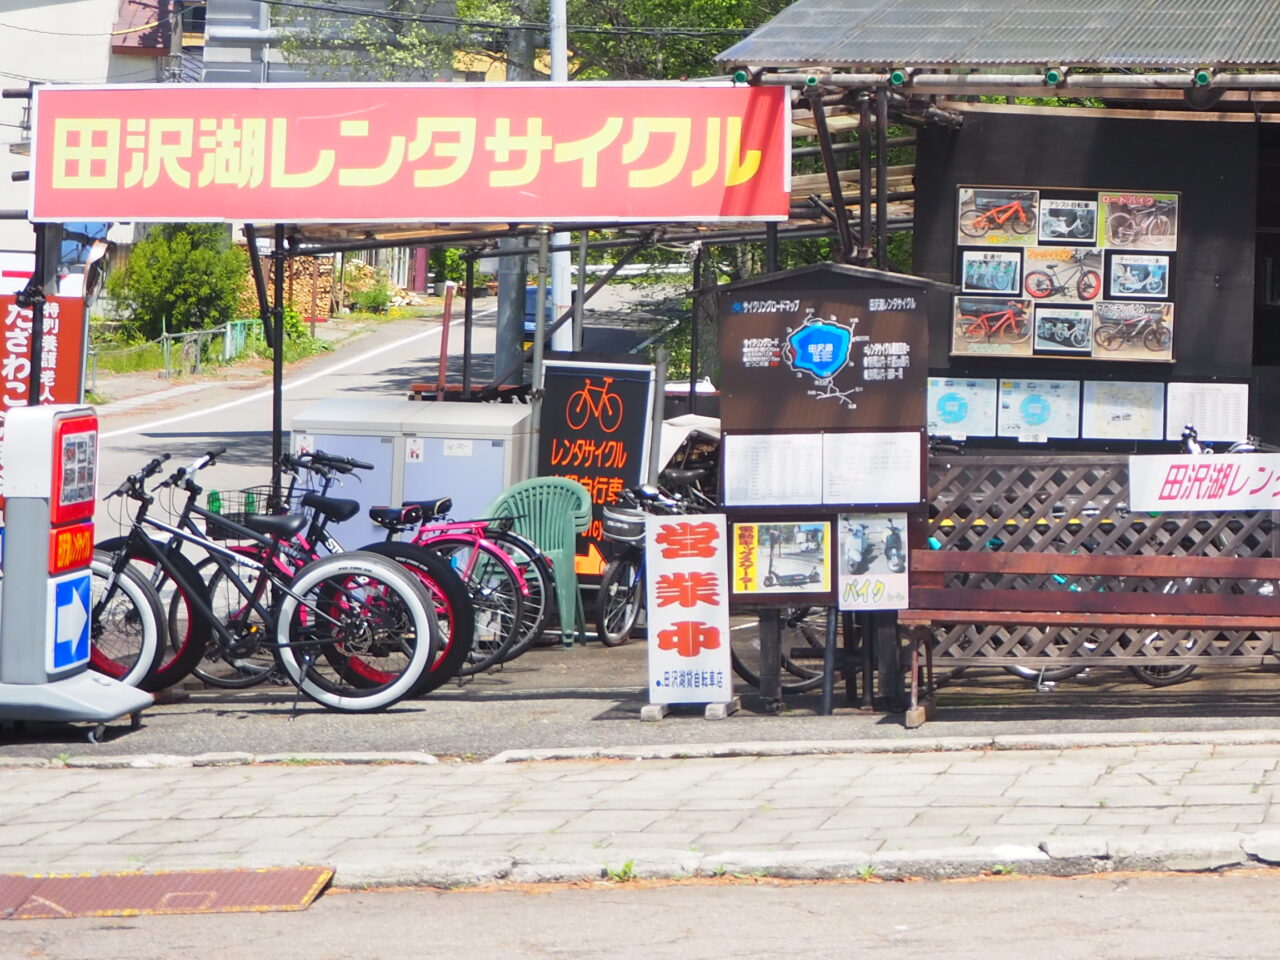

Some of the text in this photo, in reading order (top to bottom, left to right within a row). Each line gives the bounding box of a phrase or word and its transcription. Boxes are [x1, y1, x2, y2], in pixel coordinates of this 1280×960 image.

[52, 117, 761, 190] 田沢湖レンタサイクル
[1102, 195, 1154, 205] ロードバイク
[551, 438, 628, 469] レンタサイクル
[655, 522, 721, 658] 営業中
[842, 578, 887, 603] バイク
